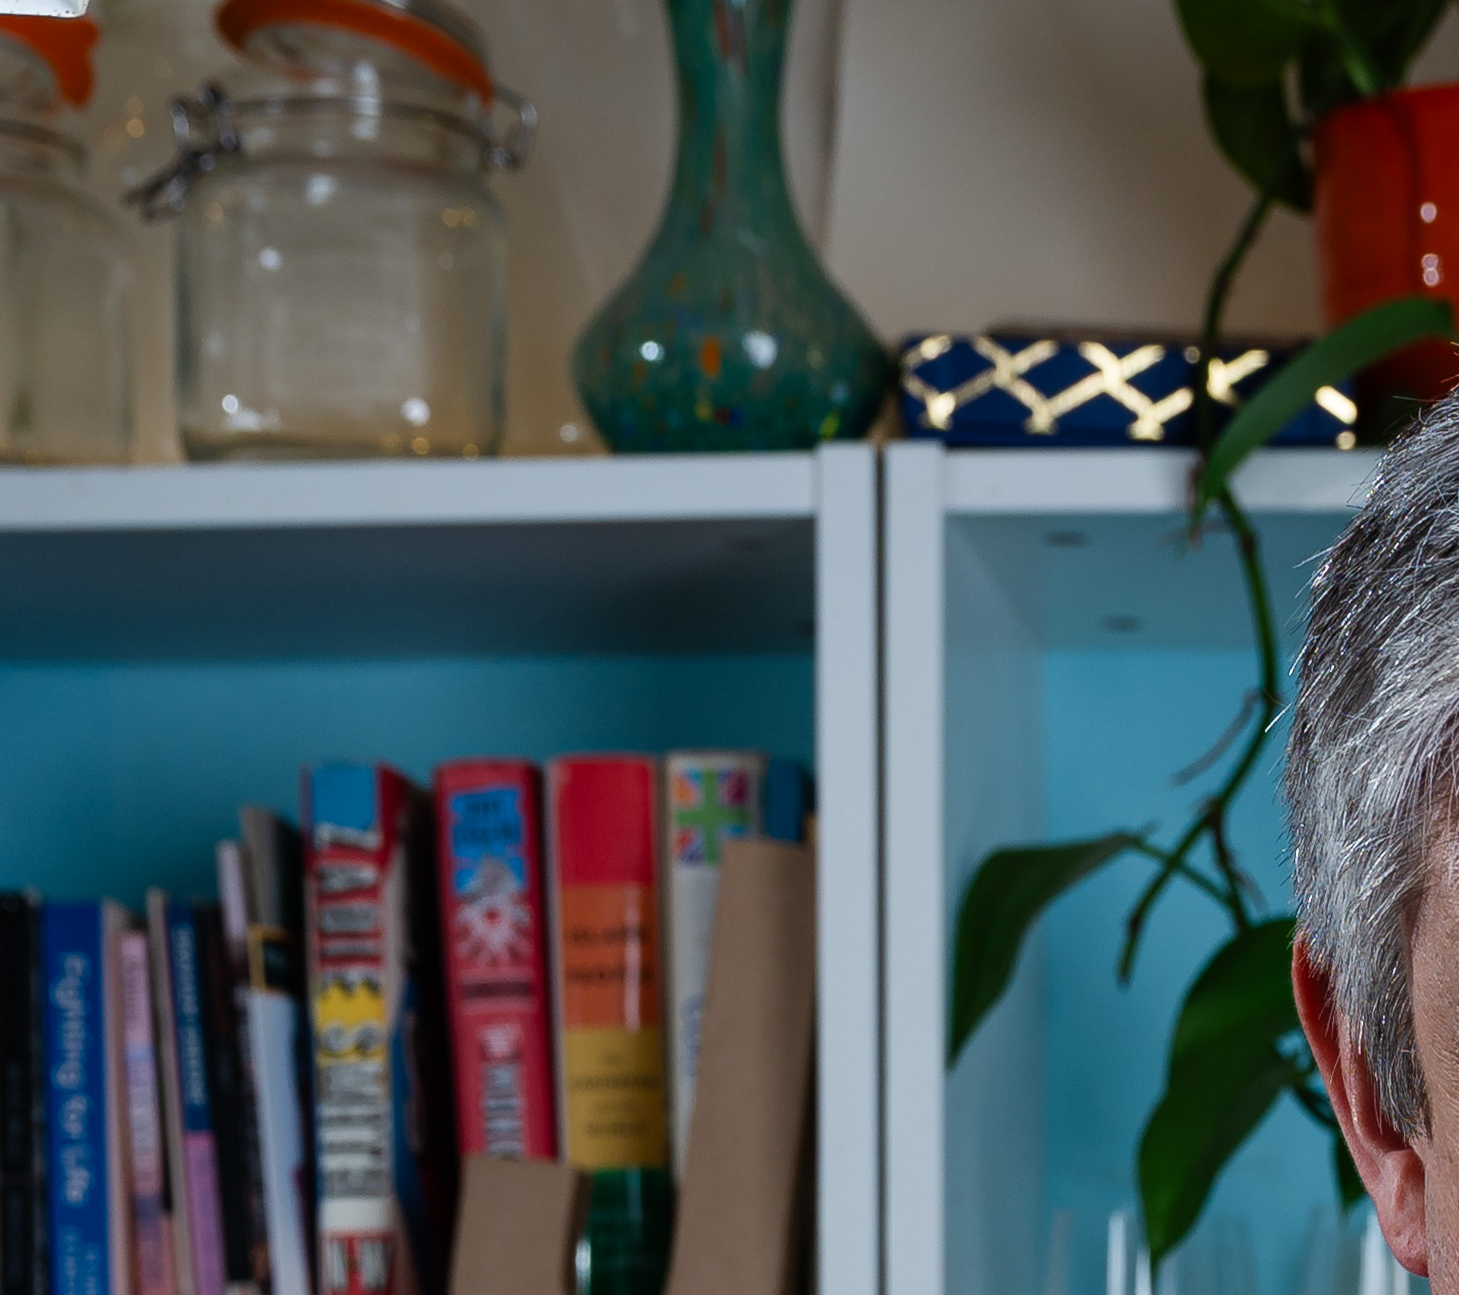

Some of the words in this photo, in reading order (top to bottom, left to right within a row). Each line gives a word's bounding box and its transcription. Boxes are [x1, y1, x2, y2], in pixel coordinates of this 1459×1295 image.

[312, 825, 386, 1004] ZADIE
[48, 953, 90, 1090] Fighting
[61, 1094, 90, 1140] for
[313, 1010, 391, 1198] SMITH
[61, 1147, 94, 1206] Life
